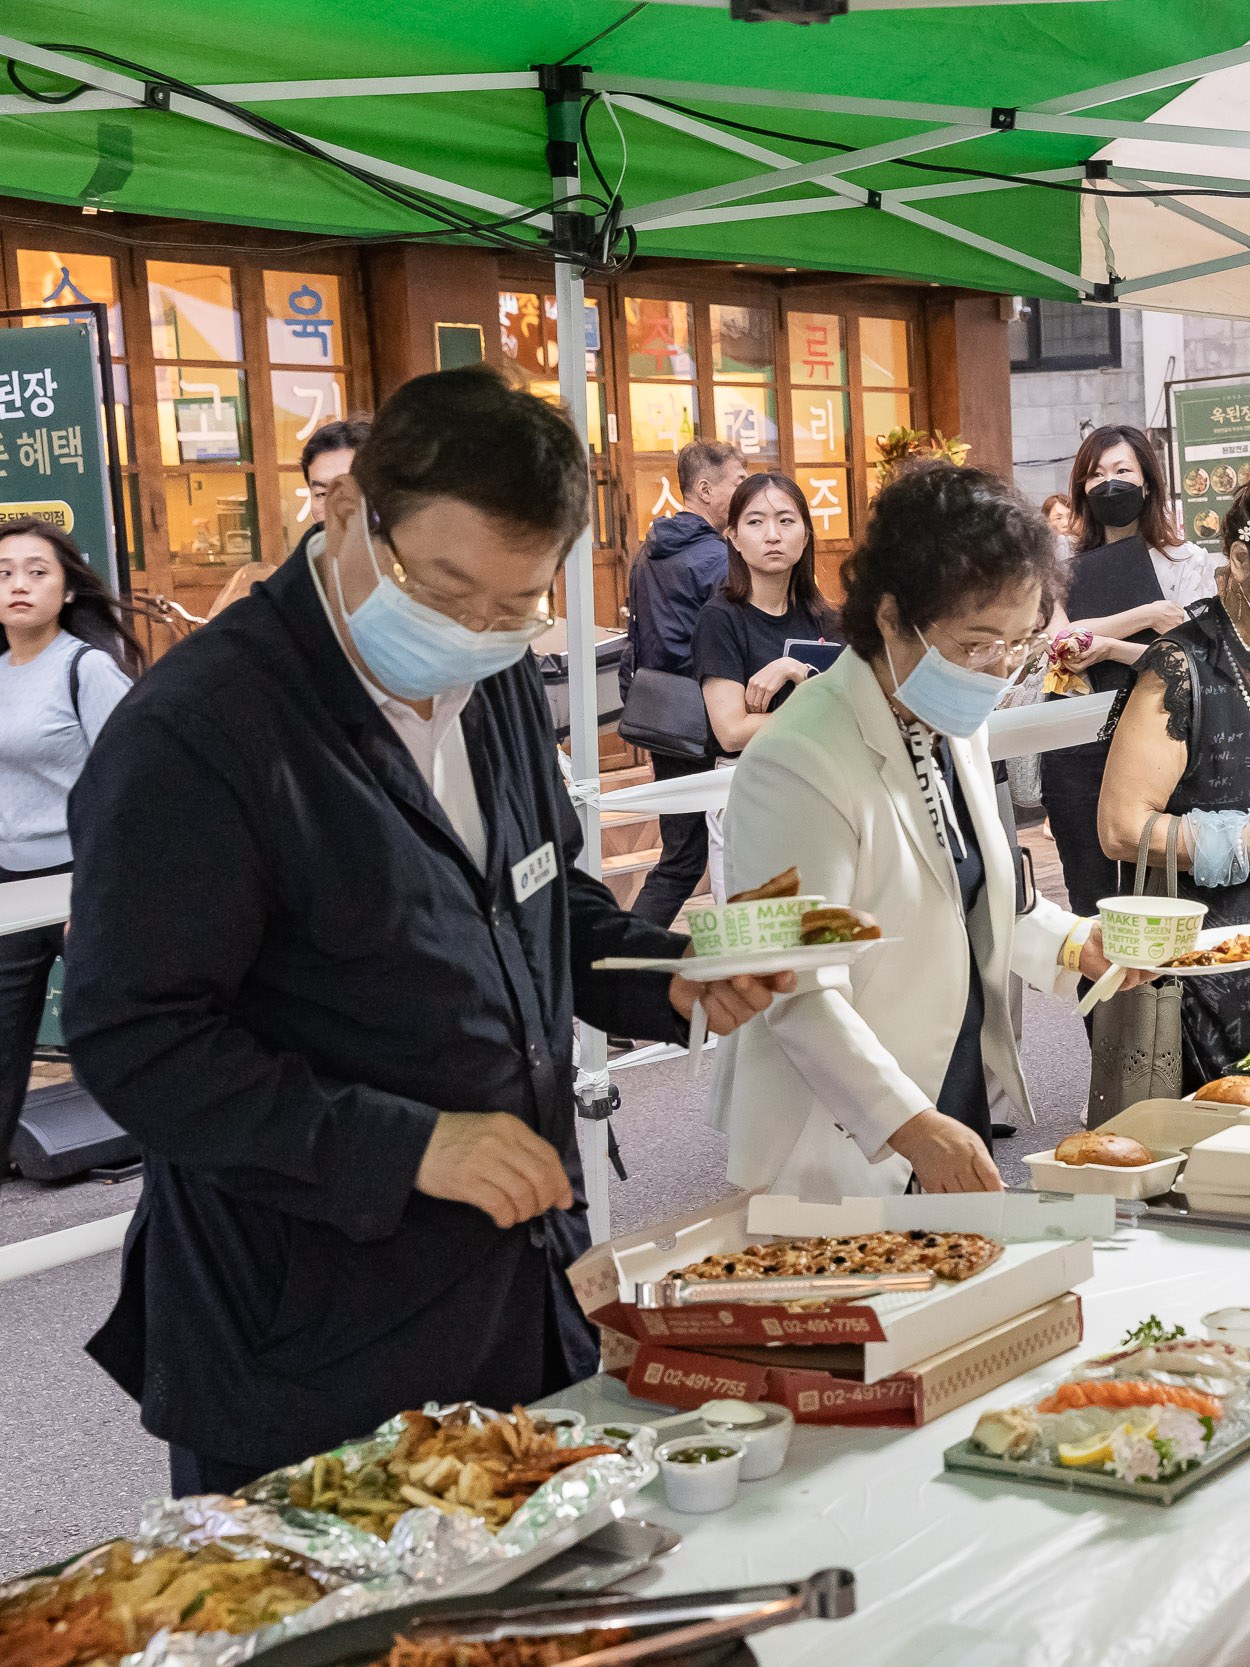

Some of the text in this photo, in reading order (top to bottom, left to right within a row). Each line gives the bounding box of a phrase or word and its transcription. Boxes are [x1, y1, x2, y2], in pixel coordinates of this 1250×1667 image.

[17, 426, 85, 476] 혜택
[1106, 911, 1140, 928] MAKE
[1175, 915, 1201, 933] ECO
[1143, 926, 1171, 935] GREEN
[1108, 942, 1140, 957] PLACE
[782, 1316, 871, 1334] 02-491-7755
[662, 1368, 748, 1398] 02-491-7755
